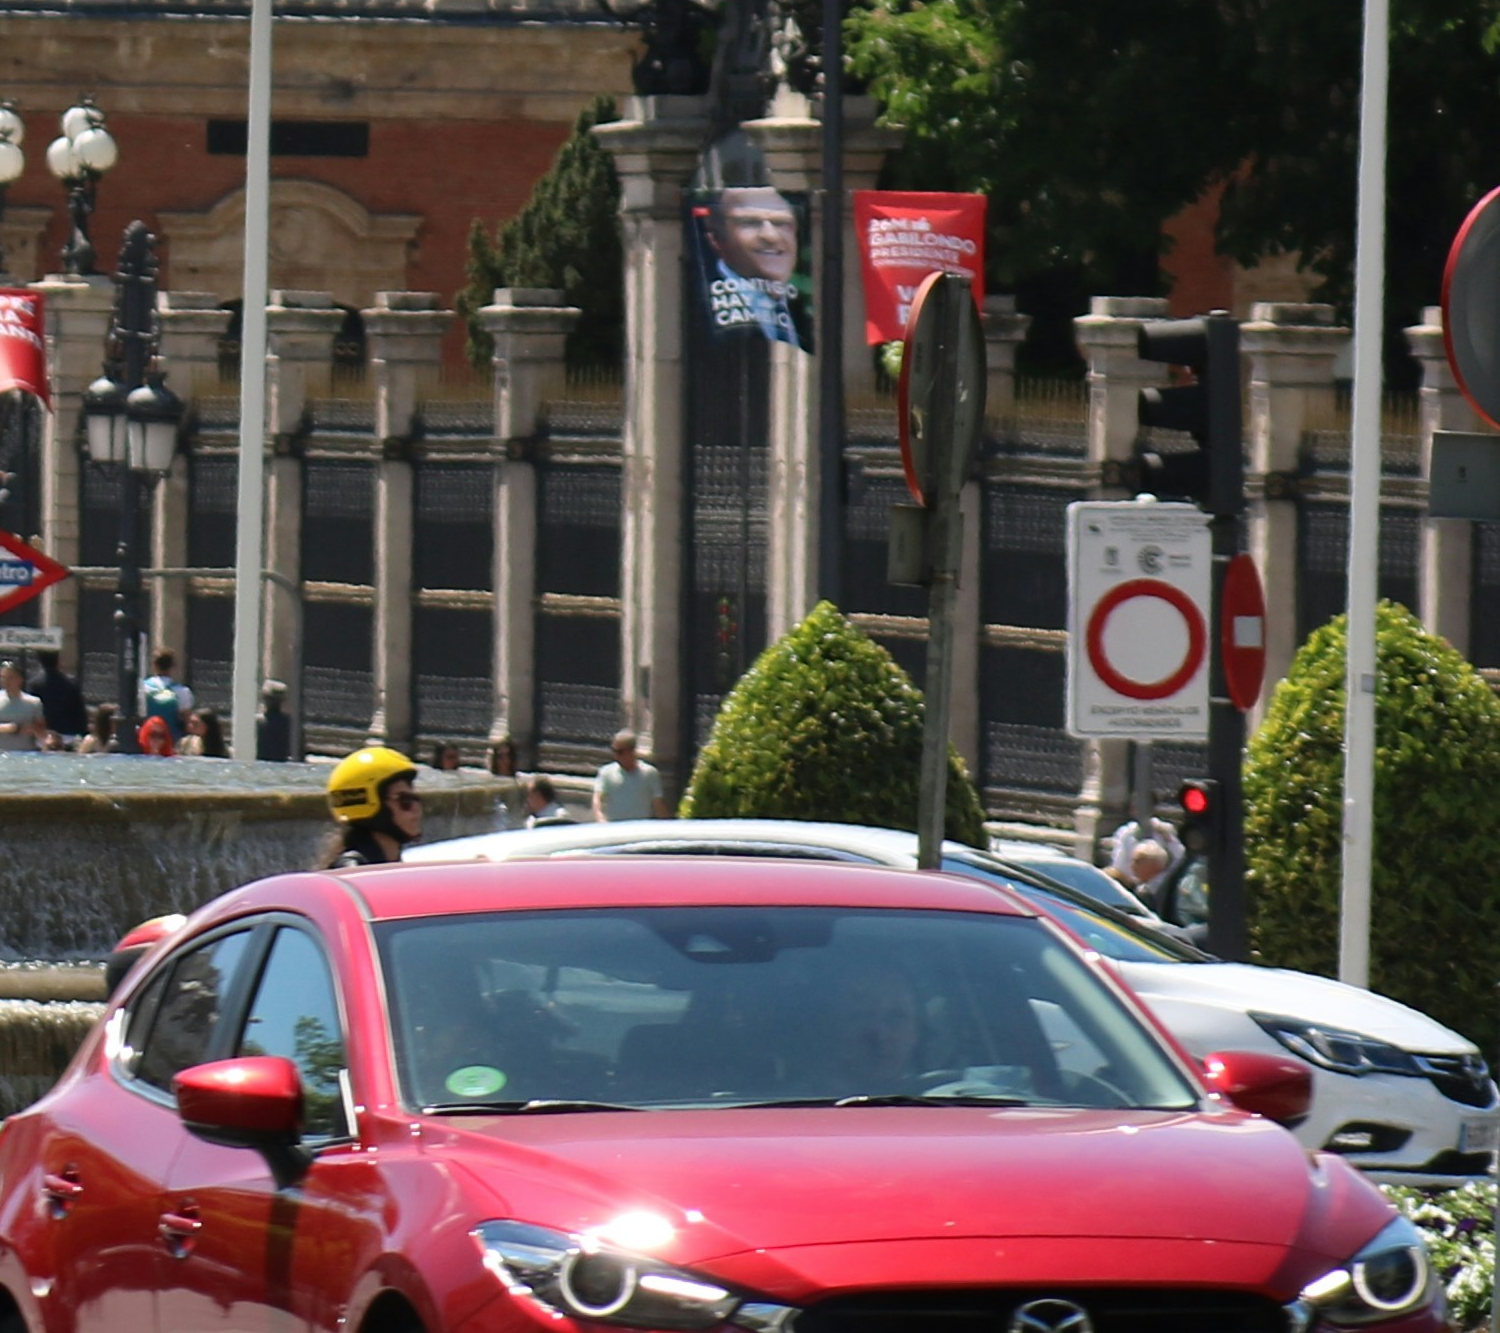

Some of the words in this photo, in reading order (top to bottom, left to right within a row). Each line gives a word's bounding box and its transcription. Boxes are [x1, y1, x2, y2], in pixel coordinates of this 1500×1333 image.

[868, 231, 977, 255] GABILONDO
[870, 245, 960, 264] PRESIDENTE
[710, 277, 799, 300] CONTIGO
[711, 294, 752, 311] HAY
[6, 630, 55, 645] España
